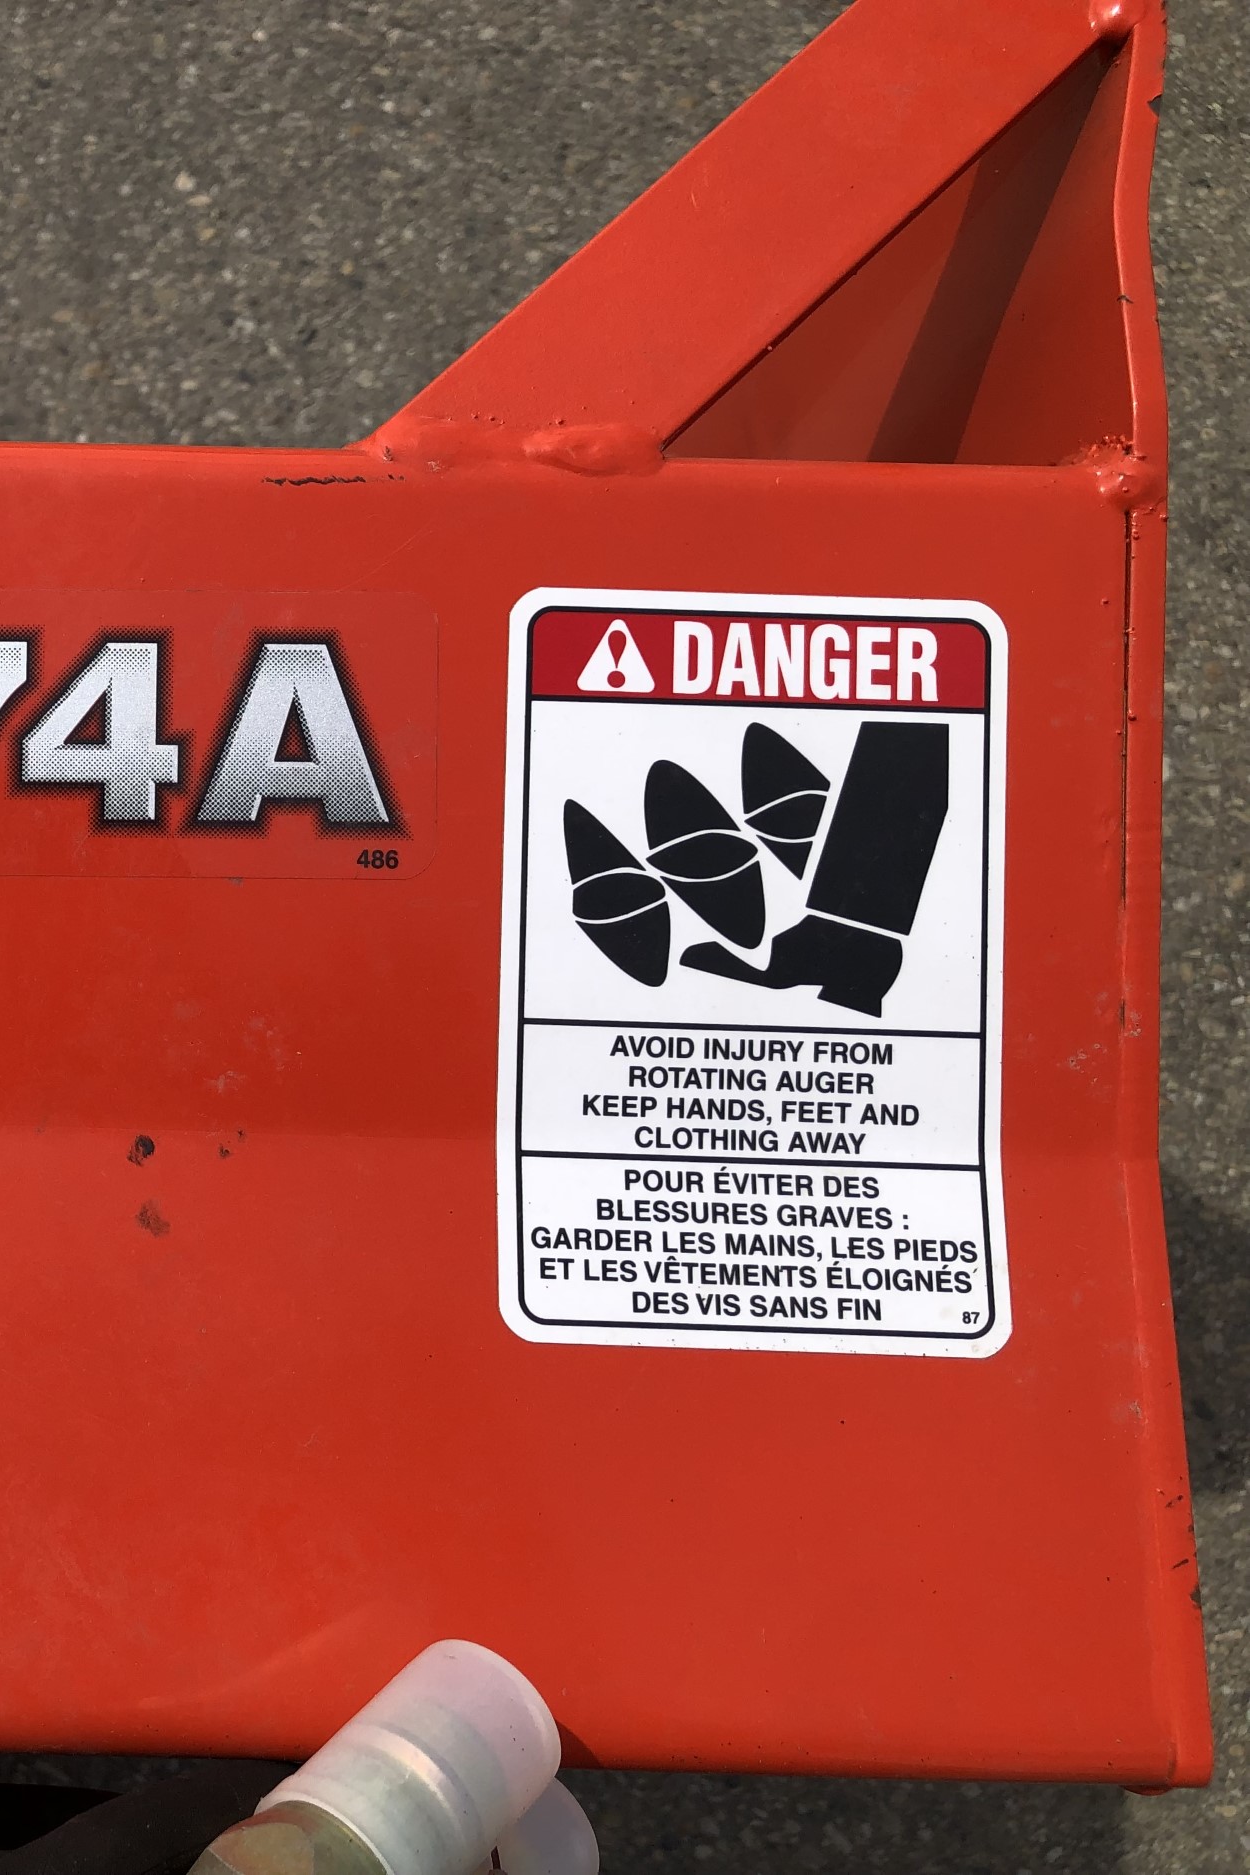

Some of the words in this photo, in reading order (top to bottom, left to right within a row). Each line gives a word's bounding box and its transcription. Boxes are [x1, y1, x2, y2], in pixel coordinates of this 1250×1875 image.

[672, 620, 939, 702] DANGER
[356, 848, 399, 869] 486
[610, 1035, 695, 1059] AVOID
[703, 1037, 805, 1063] INJURY
[813, 1041, 893, 1065] FROM
[628, 1065, 767, 1092] ROTATING
[775, 1070, 874, 1095] AUGER
[582, 1094, 658, 1118] KEEP
[666, 1097, 772, 1126] HANDS,
[781, 1100, 852, 1124] FEET
[859, 1103, 920, 1126] AND
[634, 1125, 779, 1153] CLOTHING
[787, 1131, 866, 1155] AWAY
[624, 1169, 704, 1194] POUR
[713, 1166, 814, 1197] ÉVITER
[823, 1175, 880, 1199] DES
[596, 1198, 768, 1226] BLESSURES
[776, 1204, 893, 1230] GRAVES
[530, 1226, 653, 1253] GARDER
[662, 1231, 716, 1255] LES
[725, 1233, 823, 1262] MAINS,
[831, 1236, 885, 1260] LES
[893, 1238, 978, 1264] PIEDS
[539, 1257, 575, 1280] ET
[584, 1258, 638, 1283] LES
[643, 1255, 817, 1289] VÊTEMENTS
[826, 1260, 972, 1294] ÉLOIGNÉS
[632, 1291, 690, 1315] DES
[695, 1293, 741, 1317] VIS
[749, 1294, 828, 1320] SANS
[837, 1297, 882, 1321] FIN
[962, 1311, 980, 1325] 87
